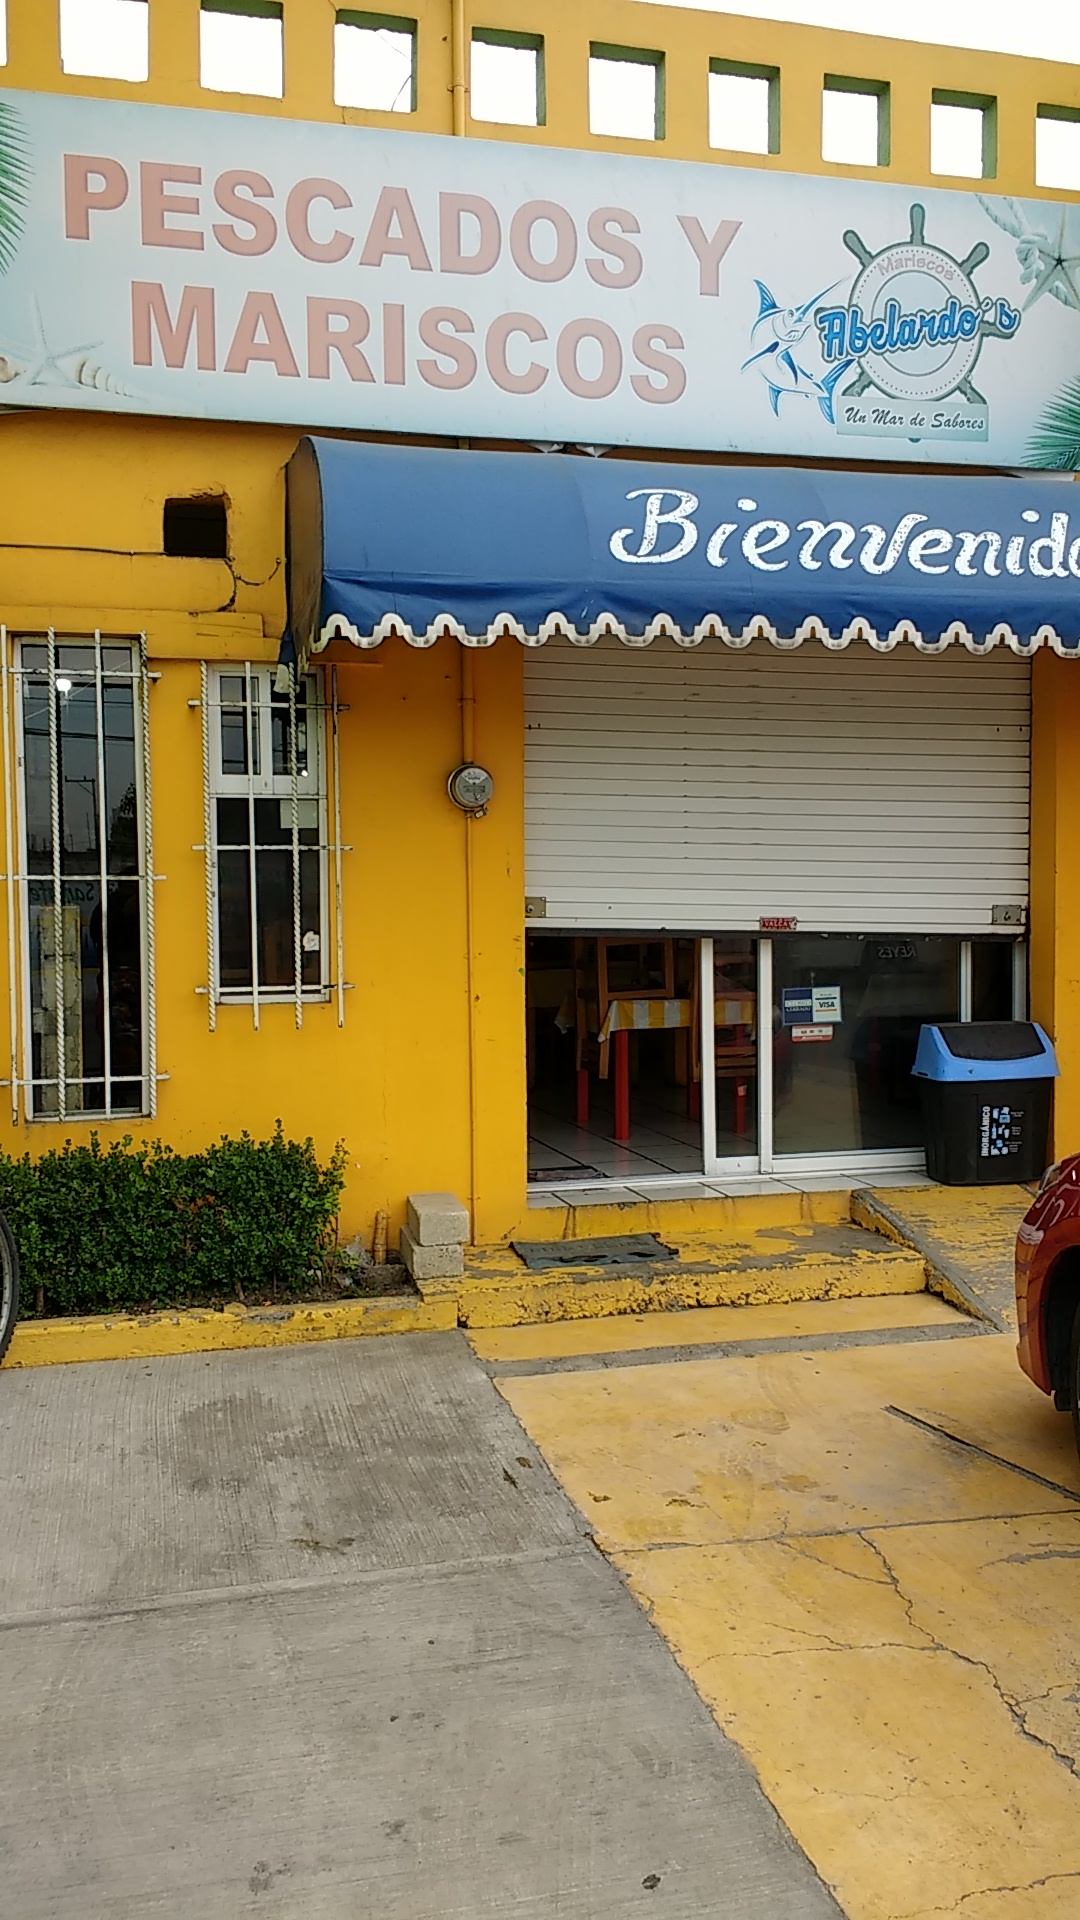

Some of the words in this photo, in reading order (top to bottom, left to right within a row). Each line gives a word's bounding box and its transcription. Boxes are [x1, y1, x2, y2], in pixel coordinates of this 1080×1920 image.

[62, 153, 644, 290] PESCADOS
[676, 214, 743, 298] Y
[877, 254, 955, 281] Mariscos
[130, 280, 687, 405] MARISCOS
[818, 300, 1018, 358] Abelardo's
[845, 406, 867, 424] Un
[871, 408, 905, 426] Mar
[909, 412, 926, 427] de
[931, 412, 984, 430] Sabores
[818, 1001, 836, 1009] VISA
[980, 1105, 991, 1157] INORGÁNICO
